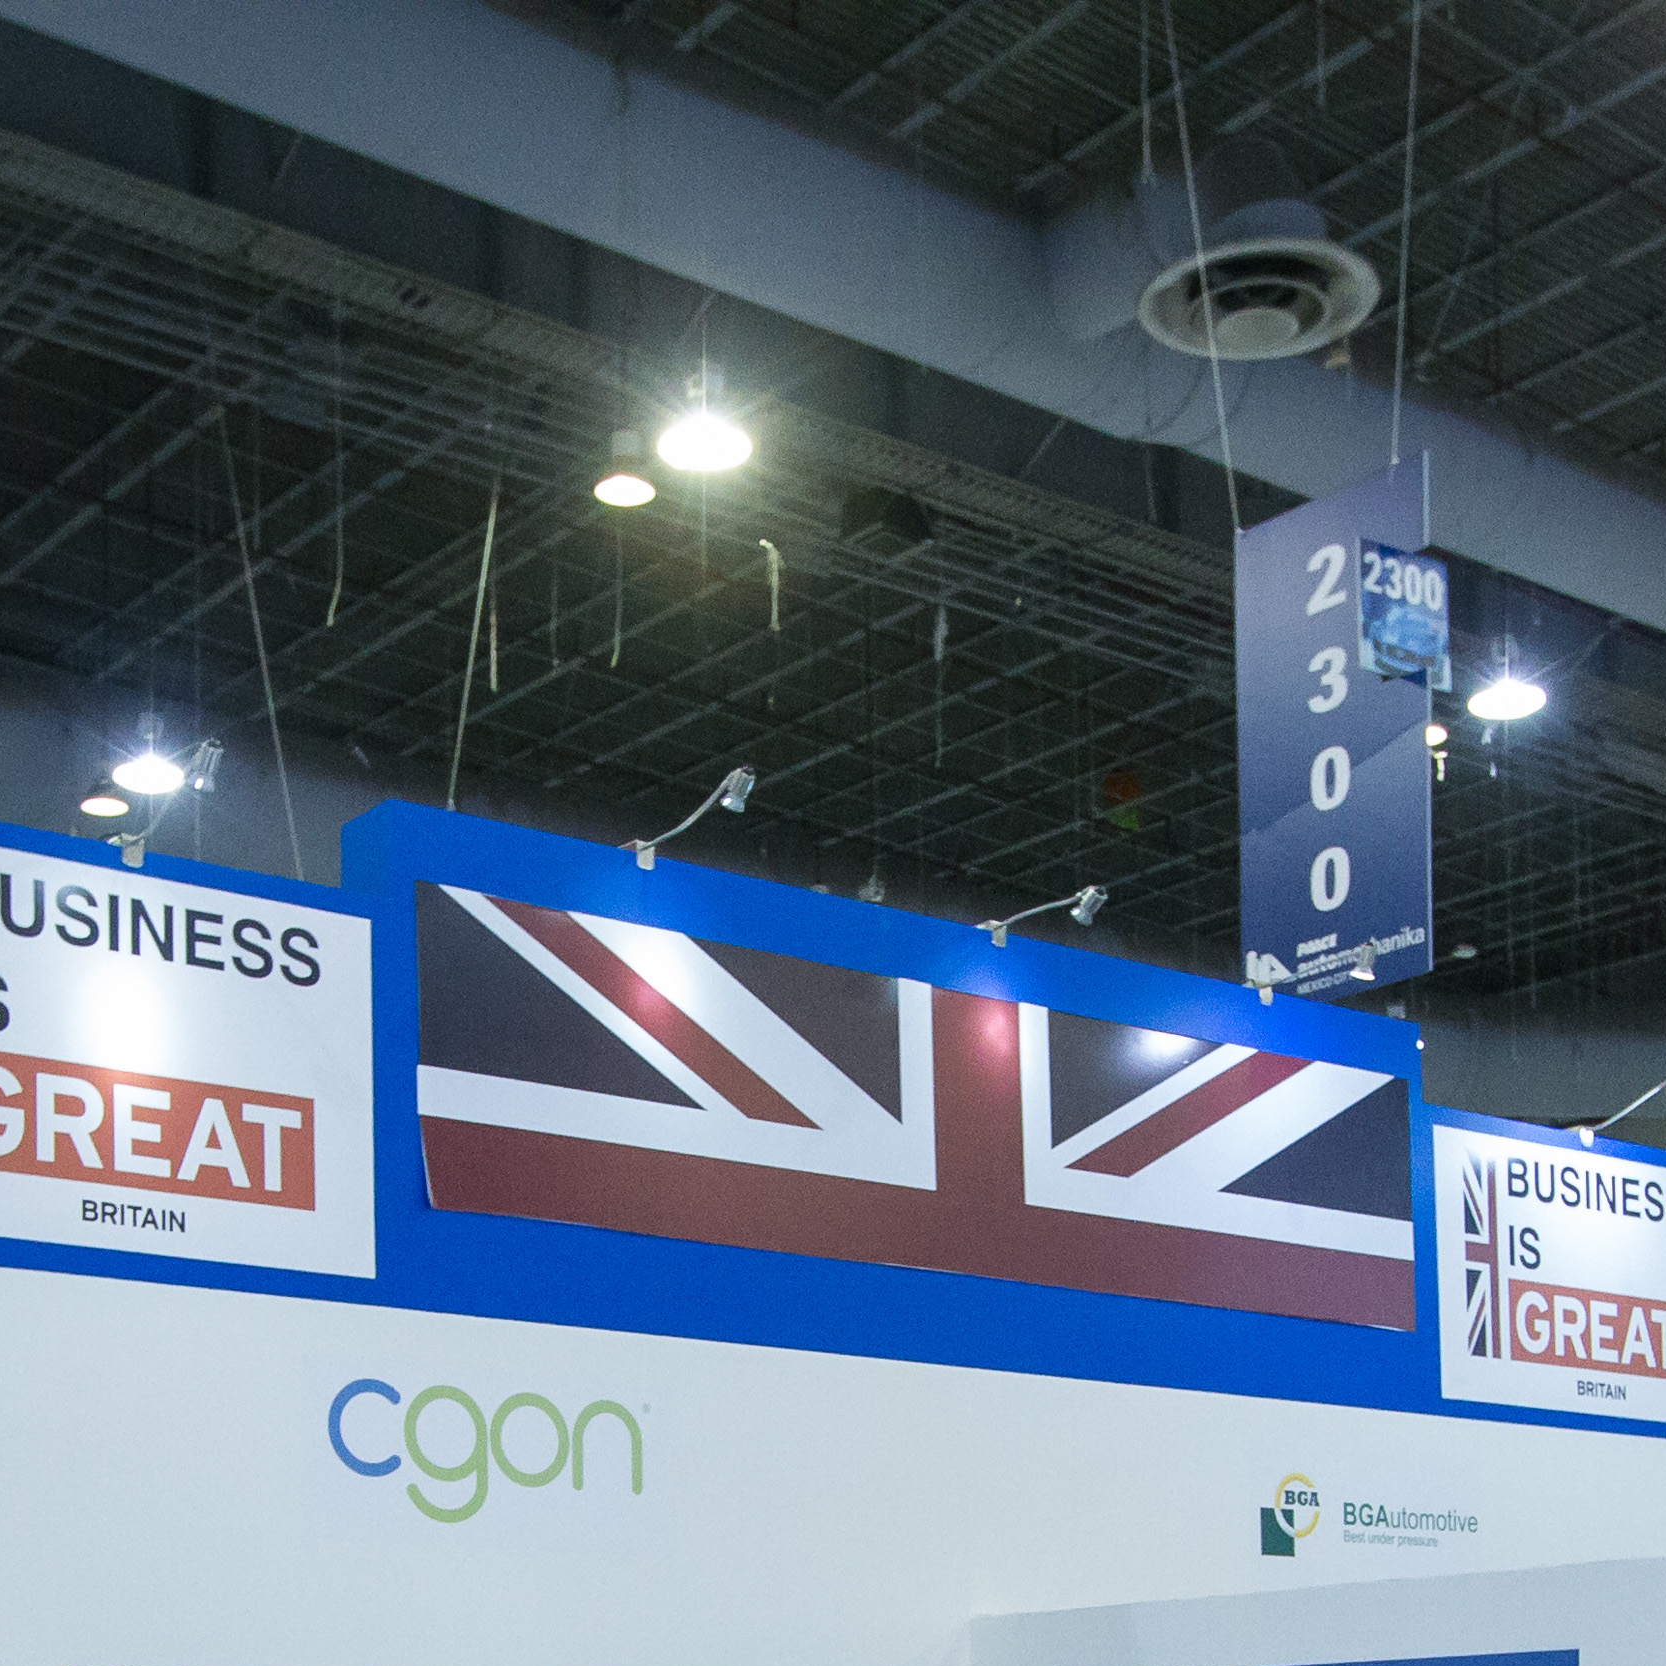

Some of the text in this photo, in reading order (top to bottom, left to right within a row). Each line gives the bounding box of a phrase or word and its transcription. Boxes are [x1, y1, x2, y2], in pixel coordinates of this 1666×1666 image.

[1363, 552, 1446, 611] 2300
[1305, 544, 1351, 912] 2300
[81, 1199, 187, 1234] BRITAIN
[1508, 1224, 1542, 1270] IS
[1576, 1379, 1628, 1401] BRITAIN
[328, 1378, 643, 1523] cgon
[1285, 1489, 1321, 1508] BGA
[1343, 1502, 1479, 1534] BGAutomotive
